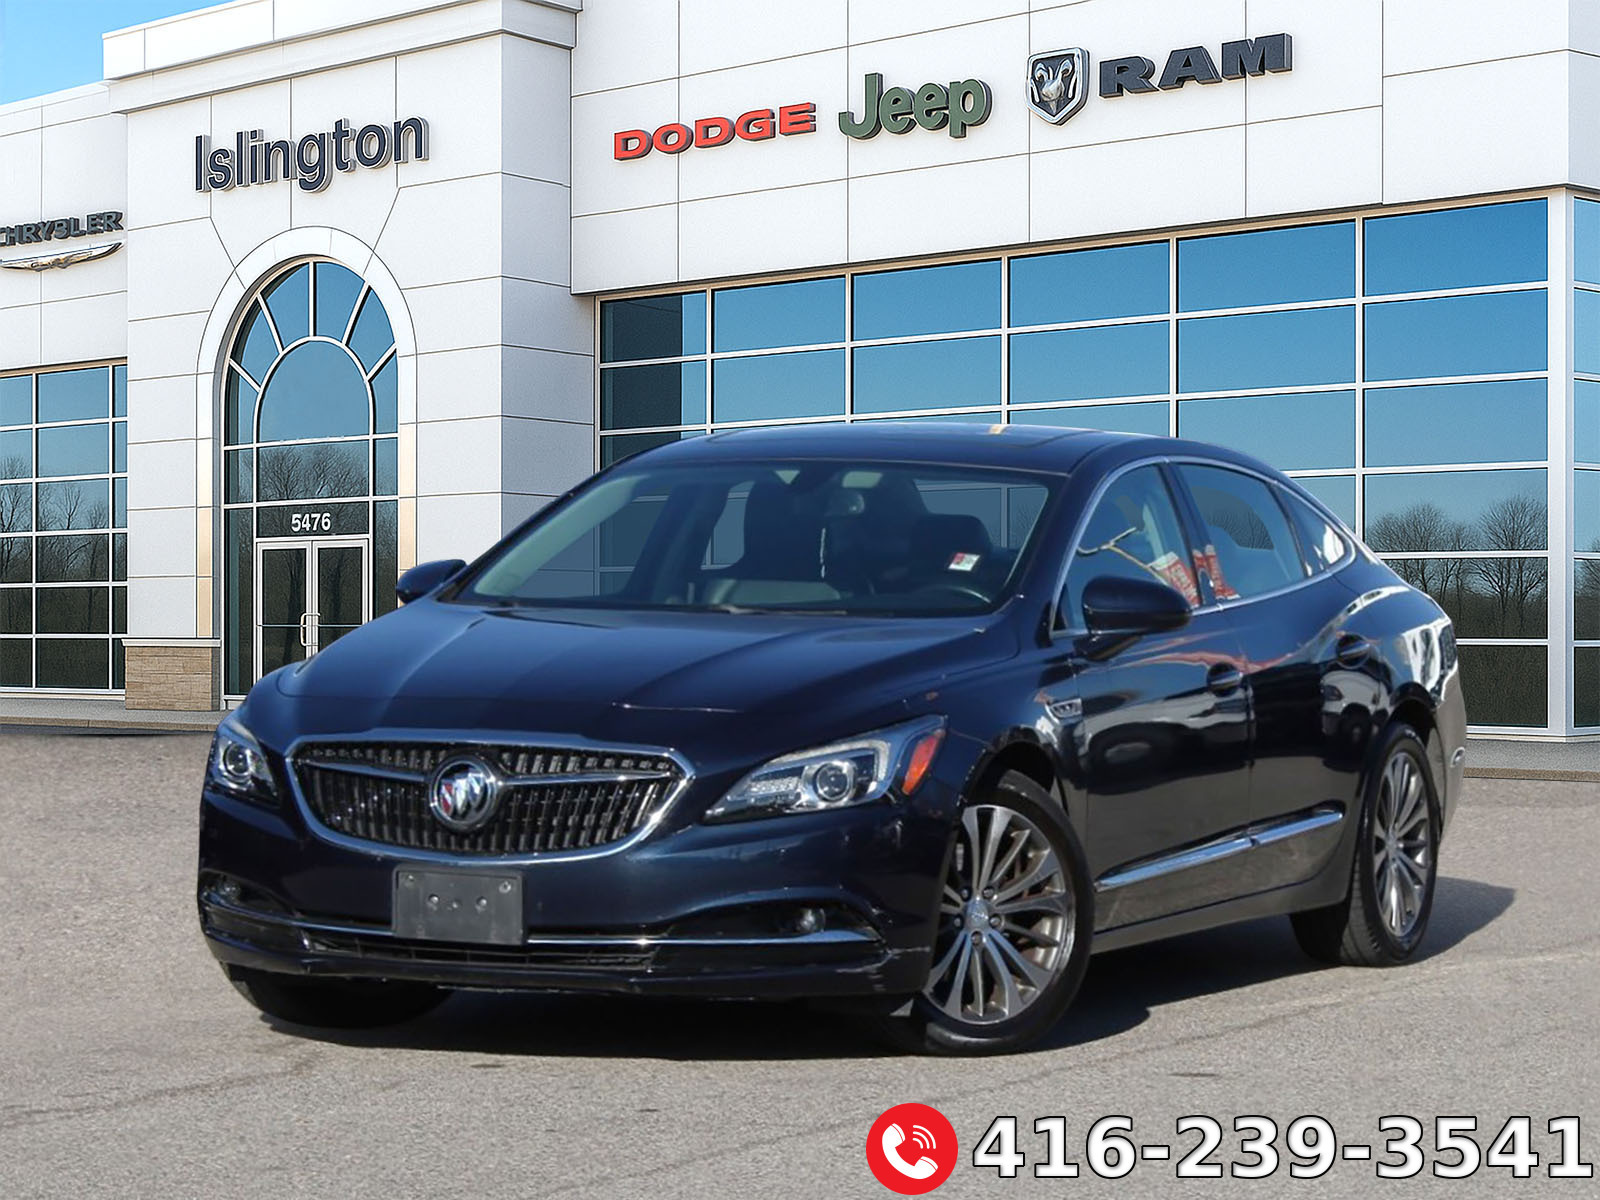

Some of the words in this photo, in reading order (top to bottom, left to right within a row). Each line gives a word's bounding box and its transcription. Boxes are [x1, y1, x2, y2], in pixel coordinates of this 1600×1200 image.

[613, 102, 818, 161] DODGE
[838, 72, 993, 140] Jeep
[1099, 32, 1294, 99] RAM
[194, 115, 430, 193] Islington
[291, 512, 331, 532] 5476
